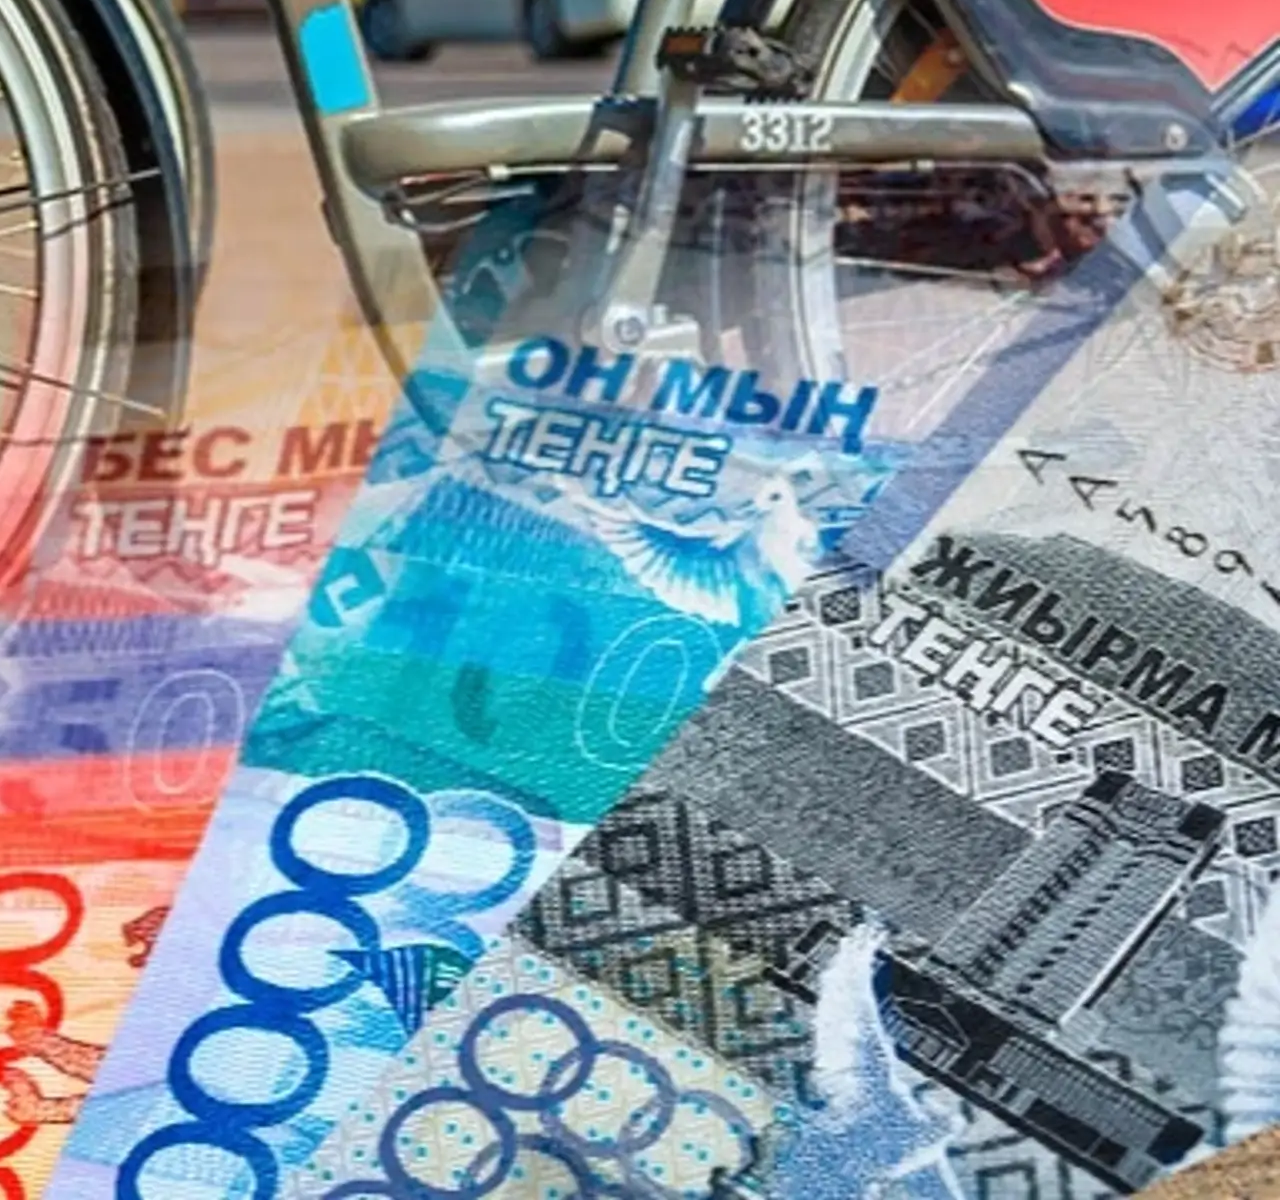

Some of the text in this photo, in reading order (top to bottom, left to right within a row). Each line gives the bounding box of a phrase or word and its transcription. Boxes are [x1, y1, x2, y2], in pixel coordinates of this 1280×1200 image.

[741, 111, 833, 152] 3312
[507, 335, 639, 401] ОН
[80, 425, 251, 484] БЕС
[909, 535, 1230, 735] ЖИЫРМА
